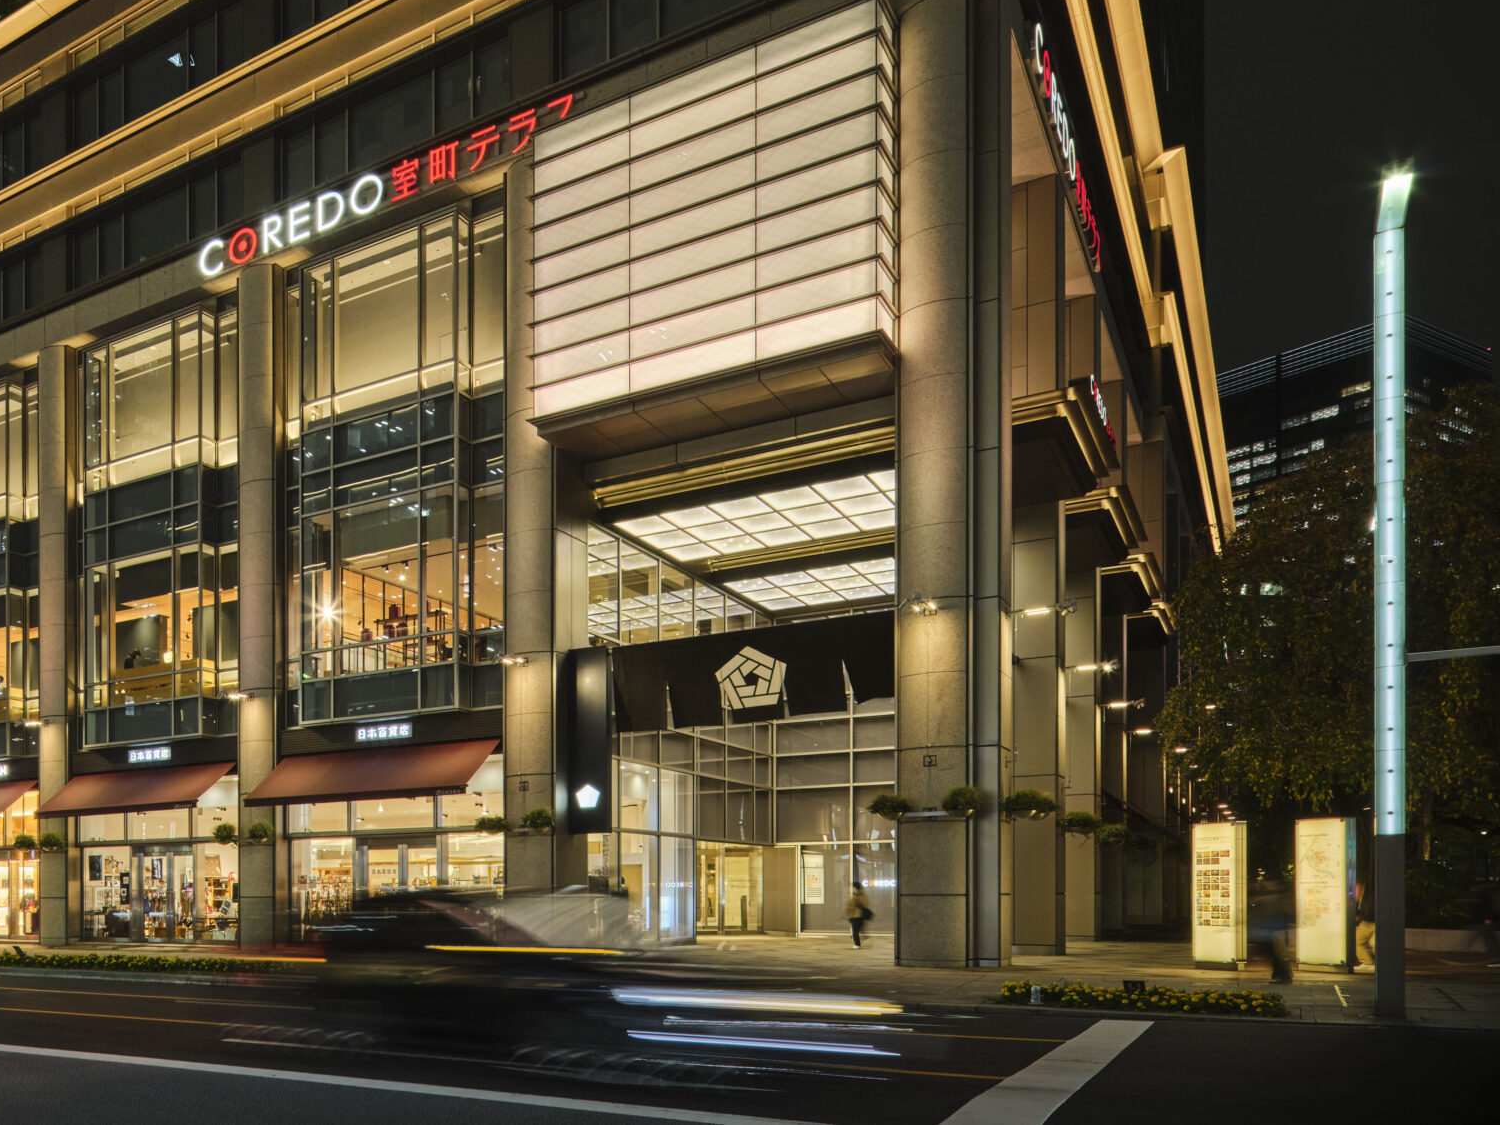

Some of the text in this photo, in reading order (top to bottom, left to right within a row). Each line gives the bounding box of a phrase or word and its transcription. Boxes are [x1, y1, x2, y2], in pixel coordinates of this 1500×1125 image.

[198, 174, 384, 277] COREDO
[357, 724, 410, 740] 日本百貨店
